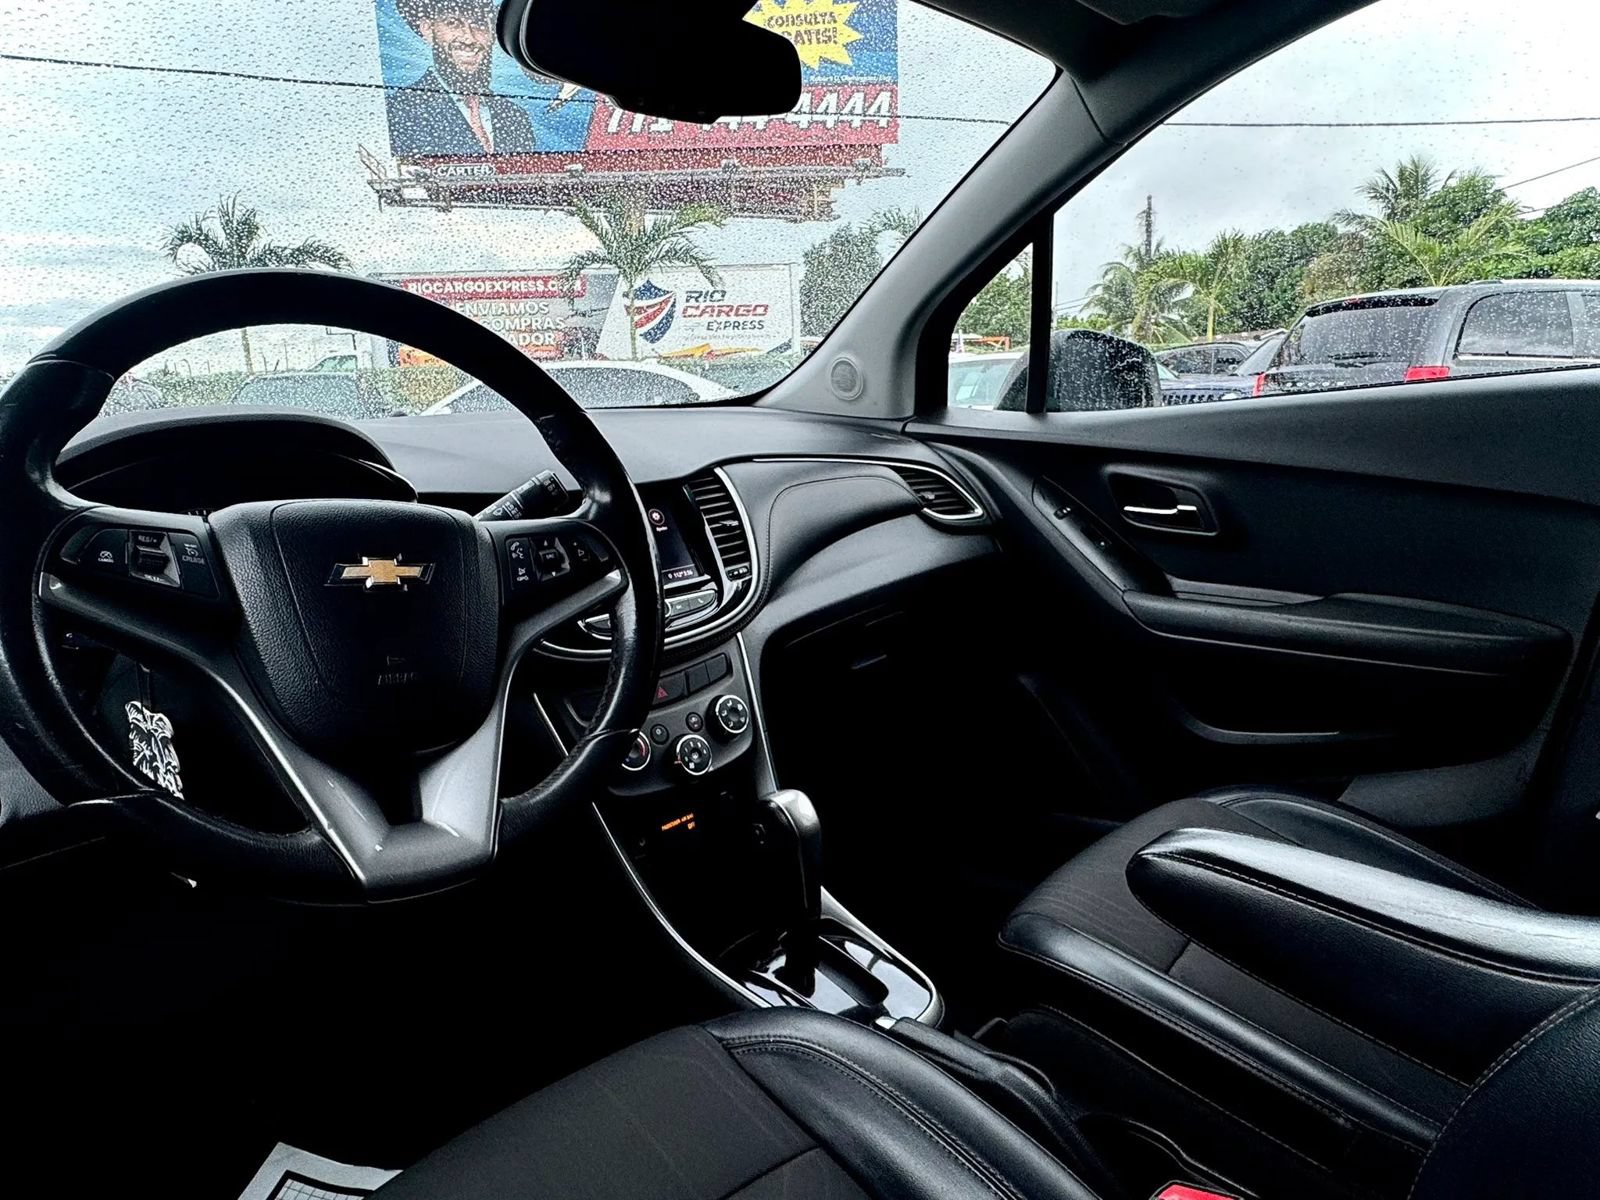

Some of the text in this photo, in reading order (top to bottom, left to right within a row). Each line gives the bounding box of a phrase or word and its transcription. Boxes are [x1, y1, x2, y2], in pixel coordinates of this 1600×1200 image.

[766, 12, 837, 28] CONSULTA
[685, 289, 727, 303] RIO
[456, 301, 550, 316] ENVIAMOS
[681, 304, 769, 318] CARGO
[706, 320, 765, 332] EXPRESS
